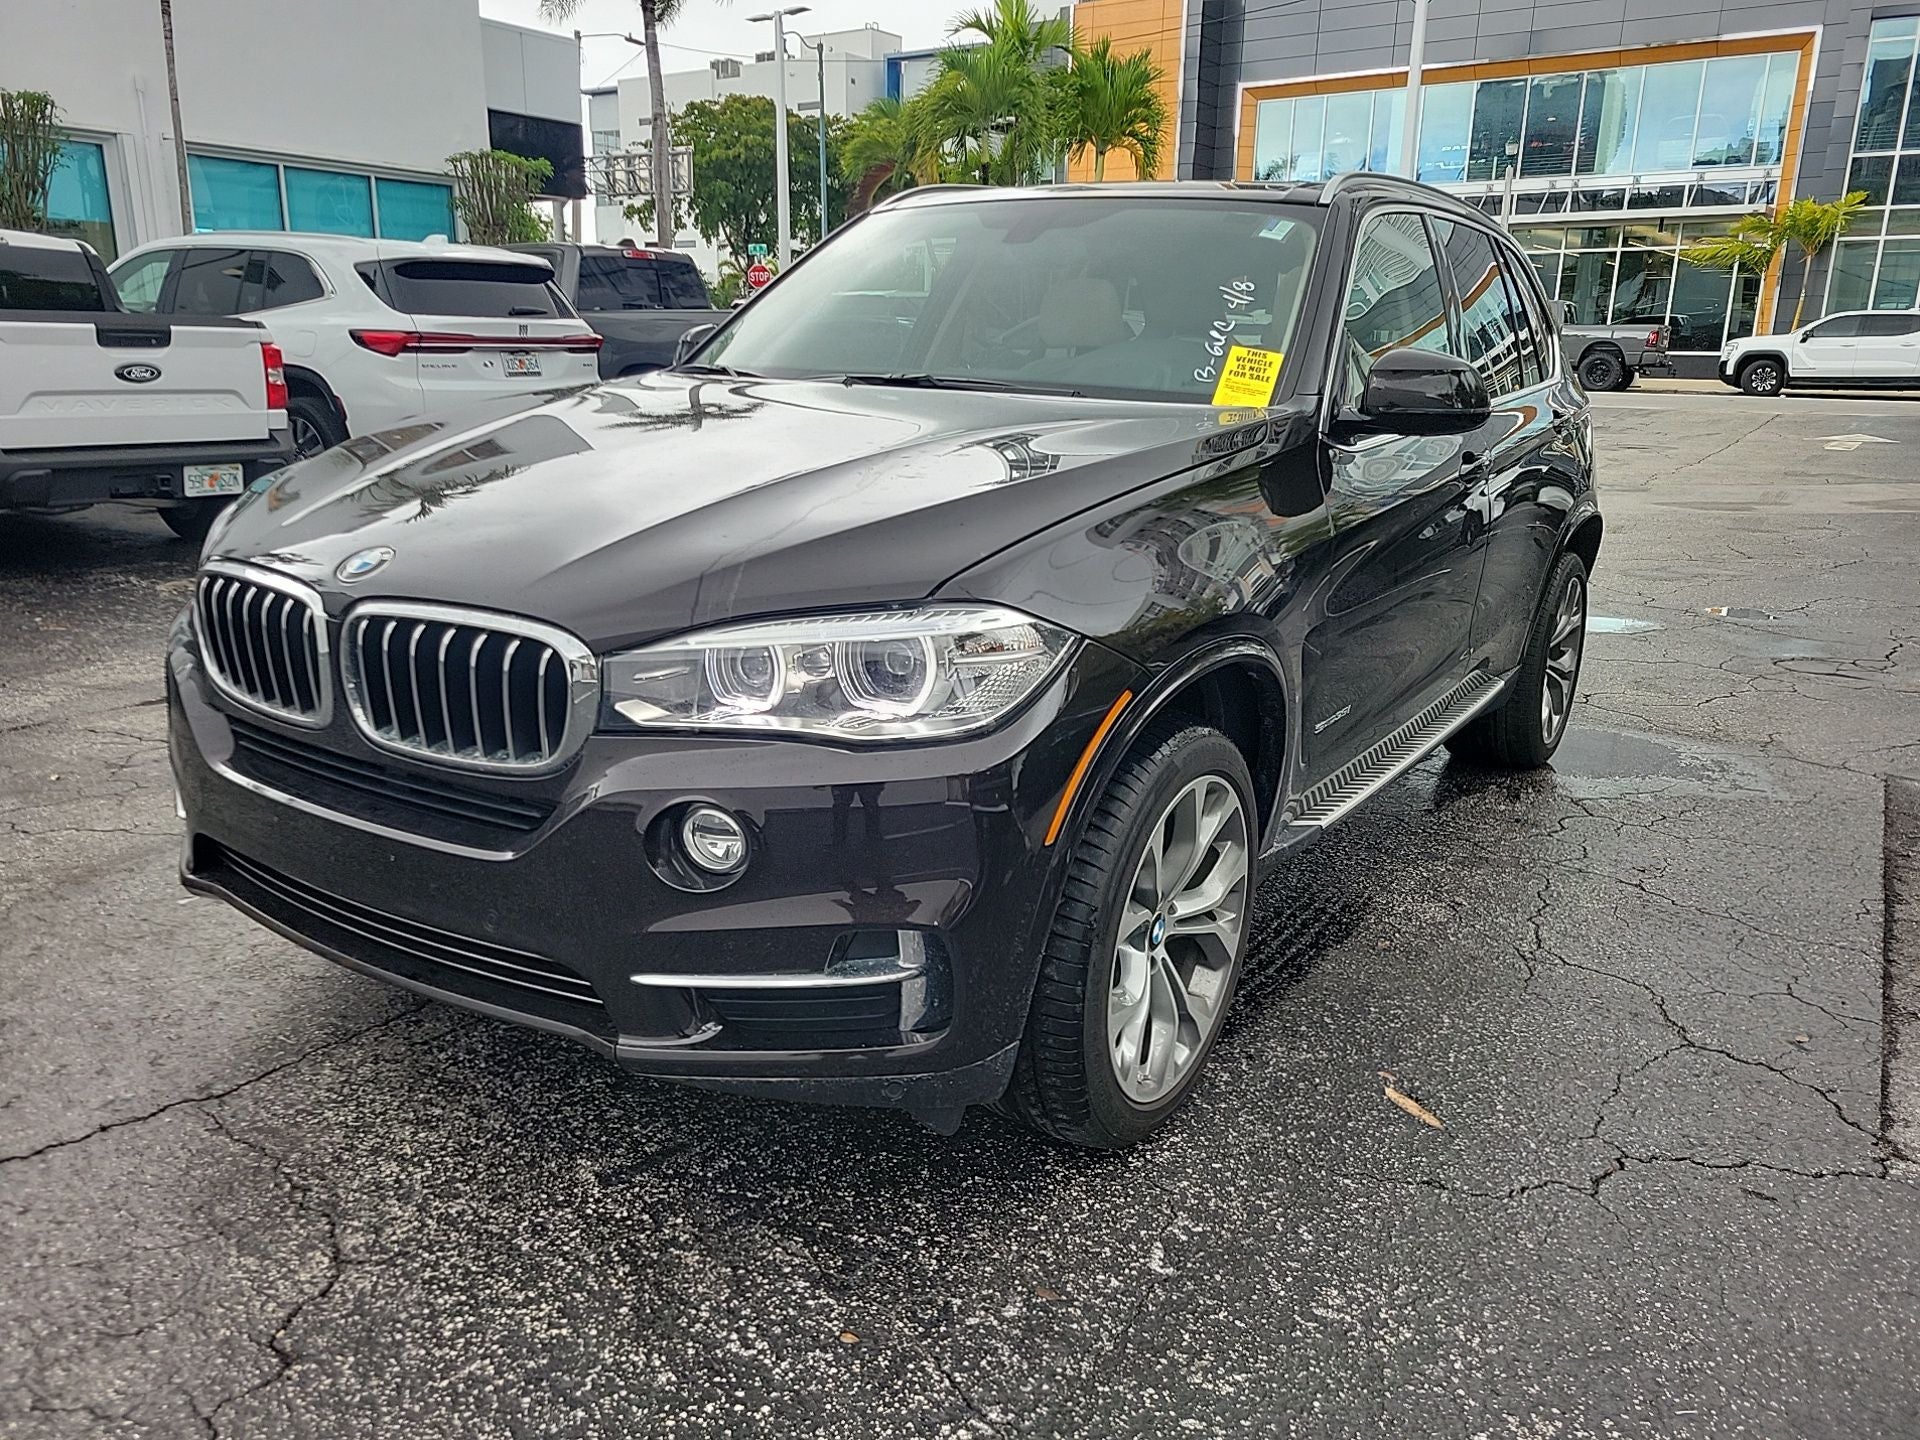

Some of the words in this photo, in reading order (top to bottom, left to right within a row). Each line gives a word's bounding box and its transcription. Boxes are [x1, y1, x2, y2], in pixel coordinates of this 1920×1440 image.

[749, 271, 770, 282] STOP
[1246, 350, 1268, 359] THIS
[1235, 355, 1274, 368] VEHICLE
[130, 367, 152, 378] Ford
[1236, 363, 1247, 371] IS
[1248, 365, 1268, 375] NOT
[1228, 369, 1247, 379] FOR
[1248, 373, 1271, 384] SALE
